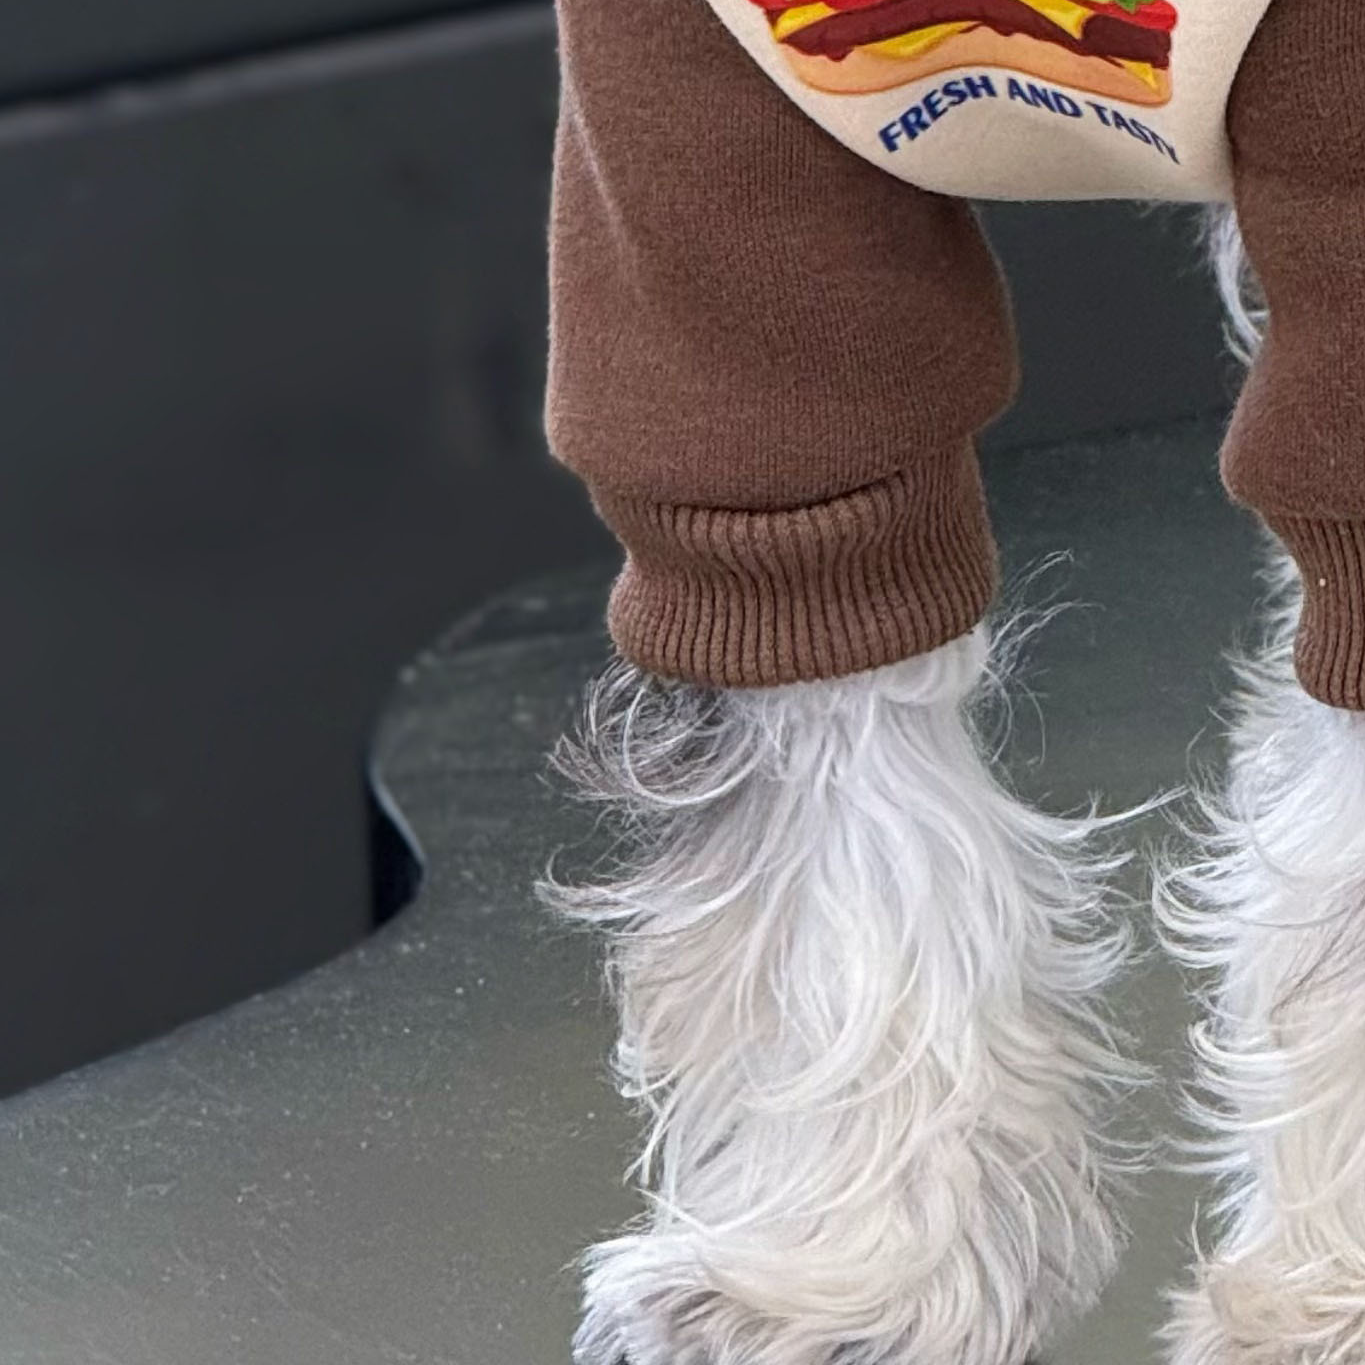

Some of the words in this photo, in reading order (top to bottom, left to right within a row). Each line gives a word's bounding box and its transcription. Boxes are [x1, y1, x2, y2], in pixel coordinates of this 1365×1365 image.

[878, 75, 997, 154] FRESH
[1007, 77, 1083, 119] AND
[1084, 100, 1181, 166] TASTY
